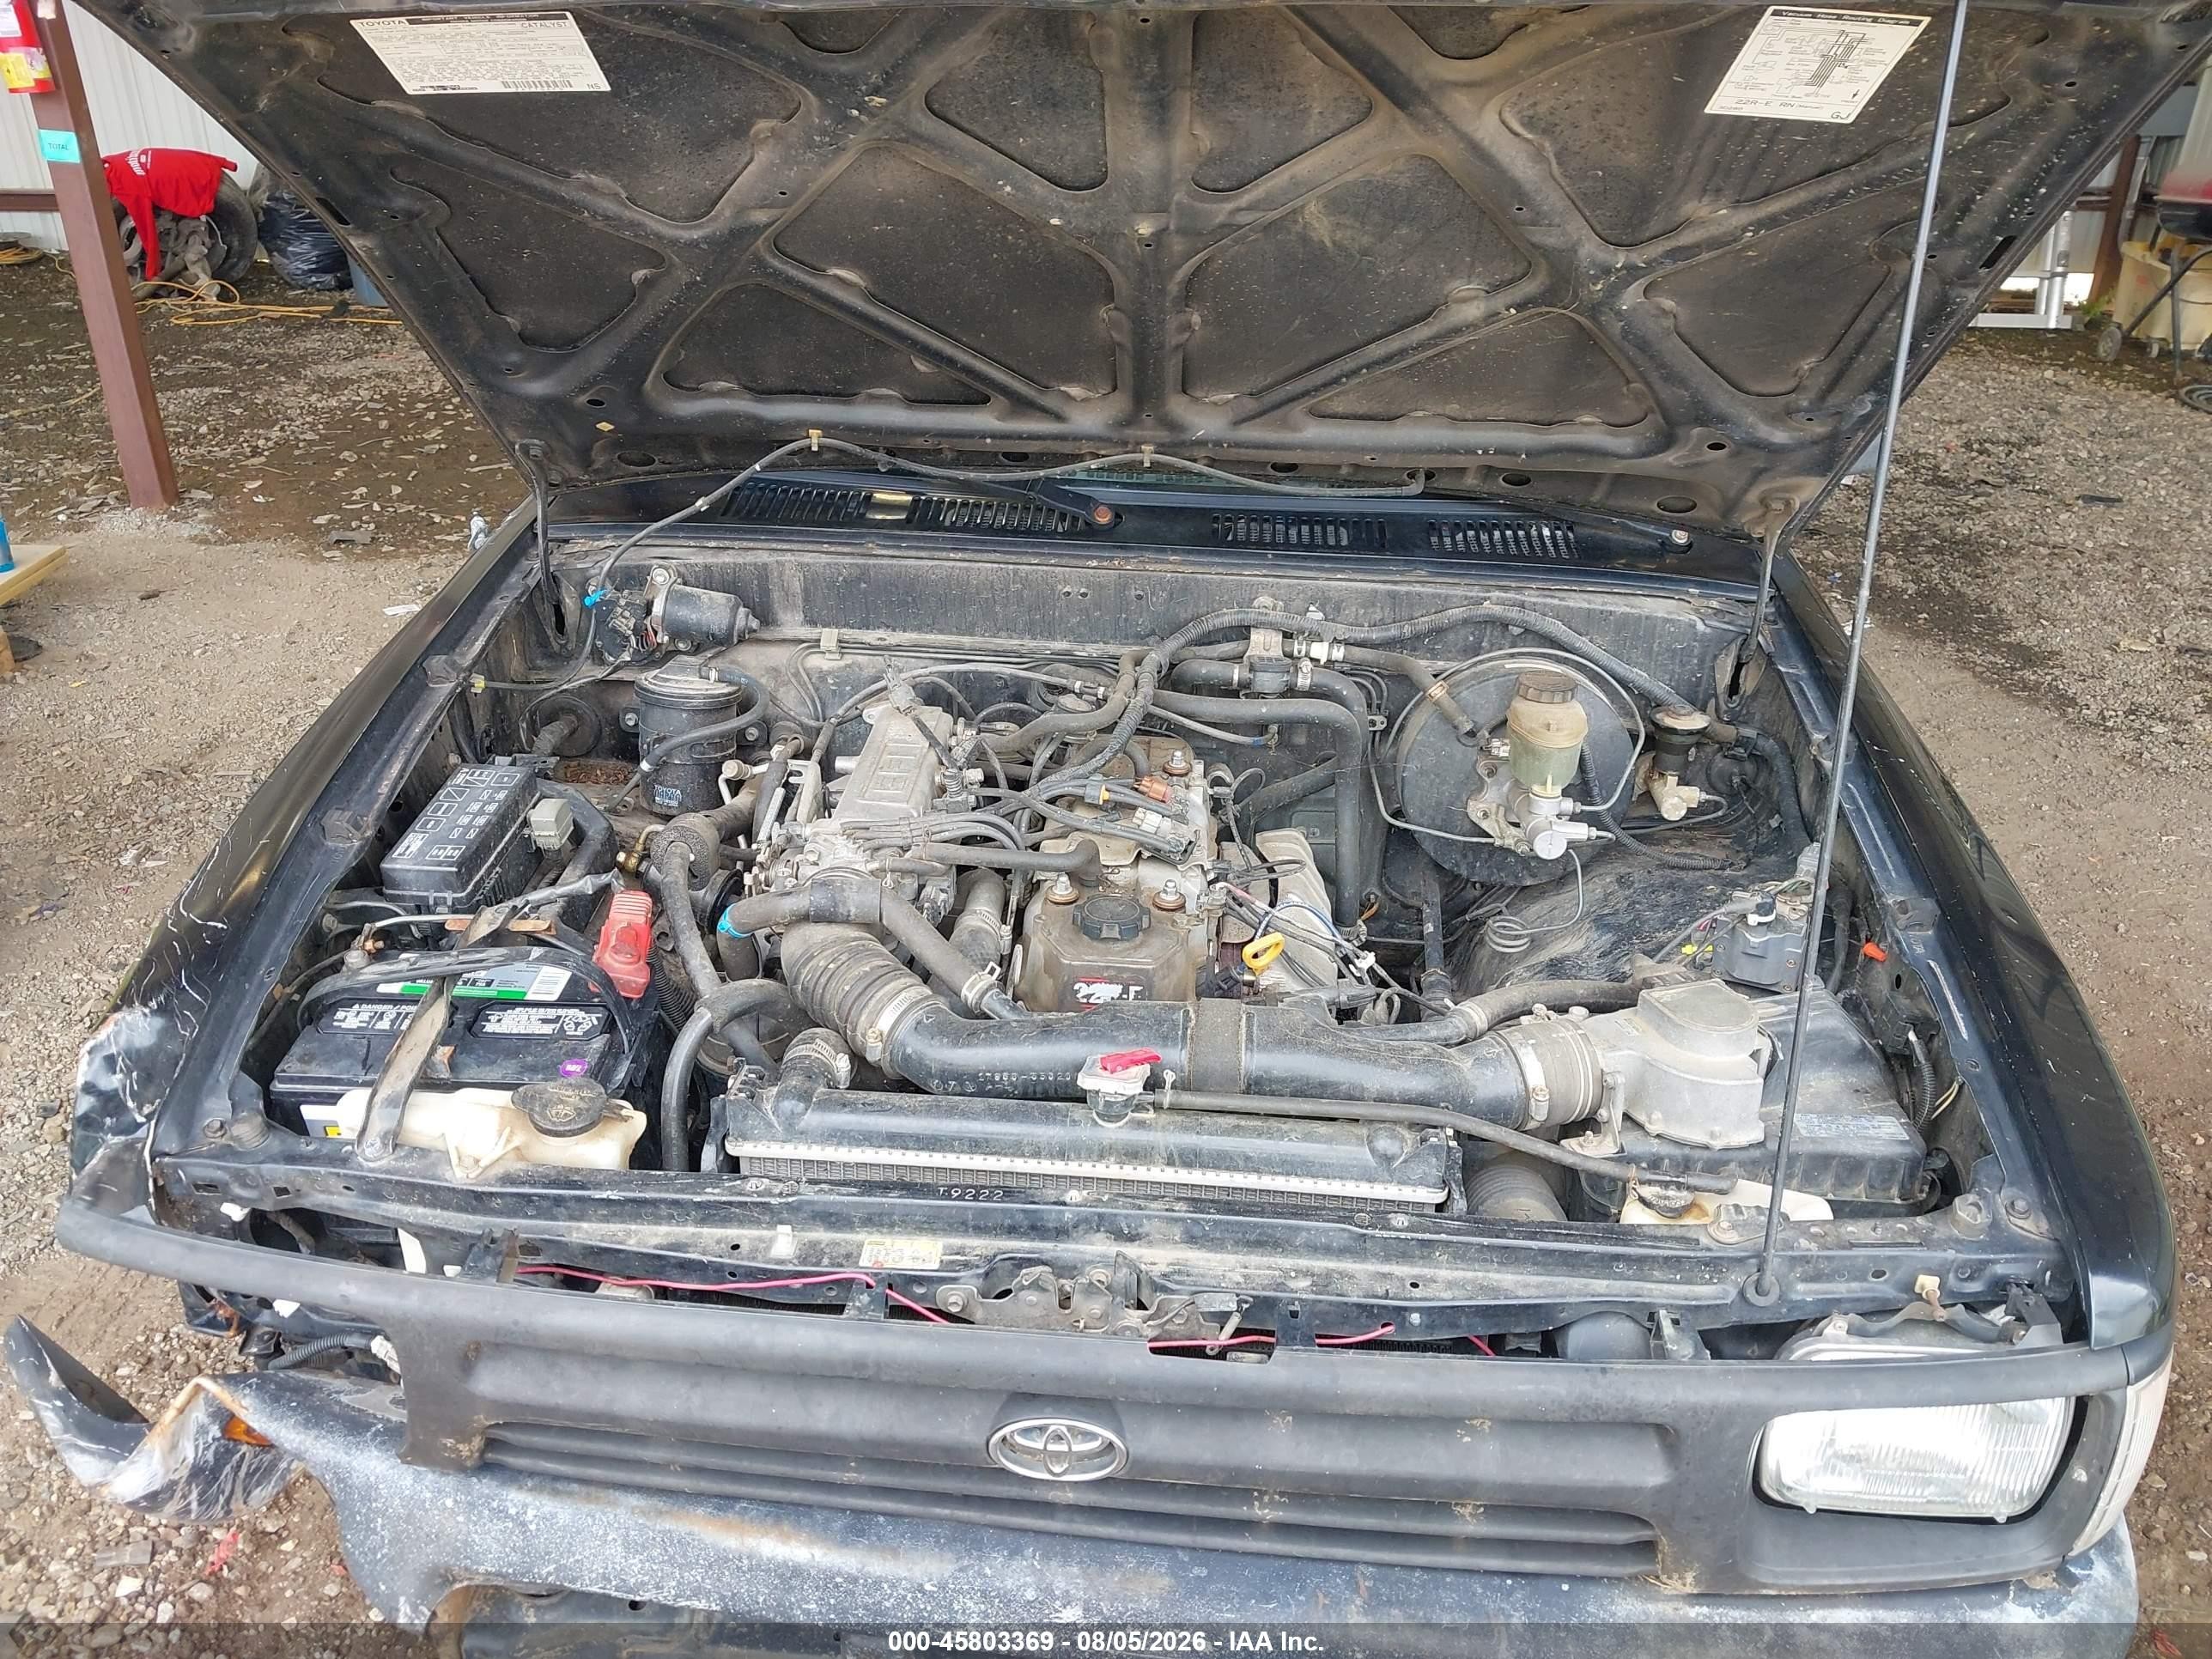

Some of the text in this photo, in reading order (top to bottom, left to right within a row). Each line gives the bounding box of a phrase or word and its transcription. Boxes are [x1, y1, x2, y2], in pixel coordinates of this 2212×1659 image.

[1735, 99, 1772, 107] 22R-E
[48, 143, 69, 151] TOTAL
[653, 783, 681, 795] TOYOTA
